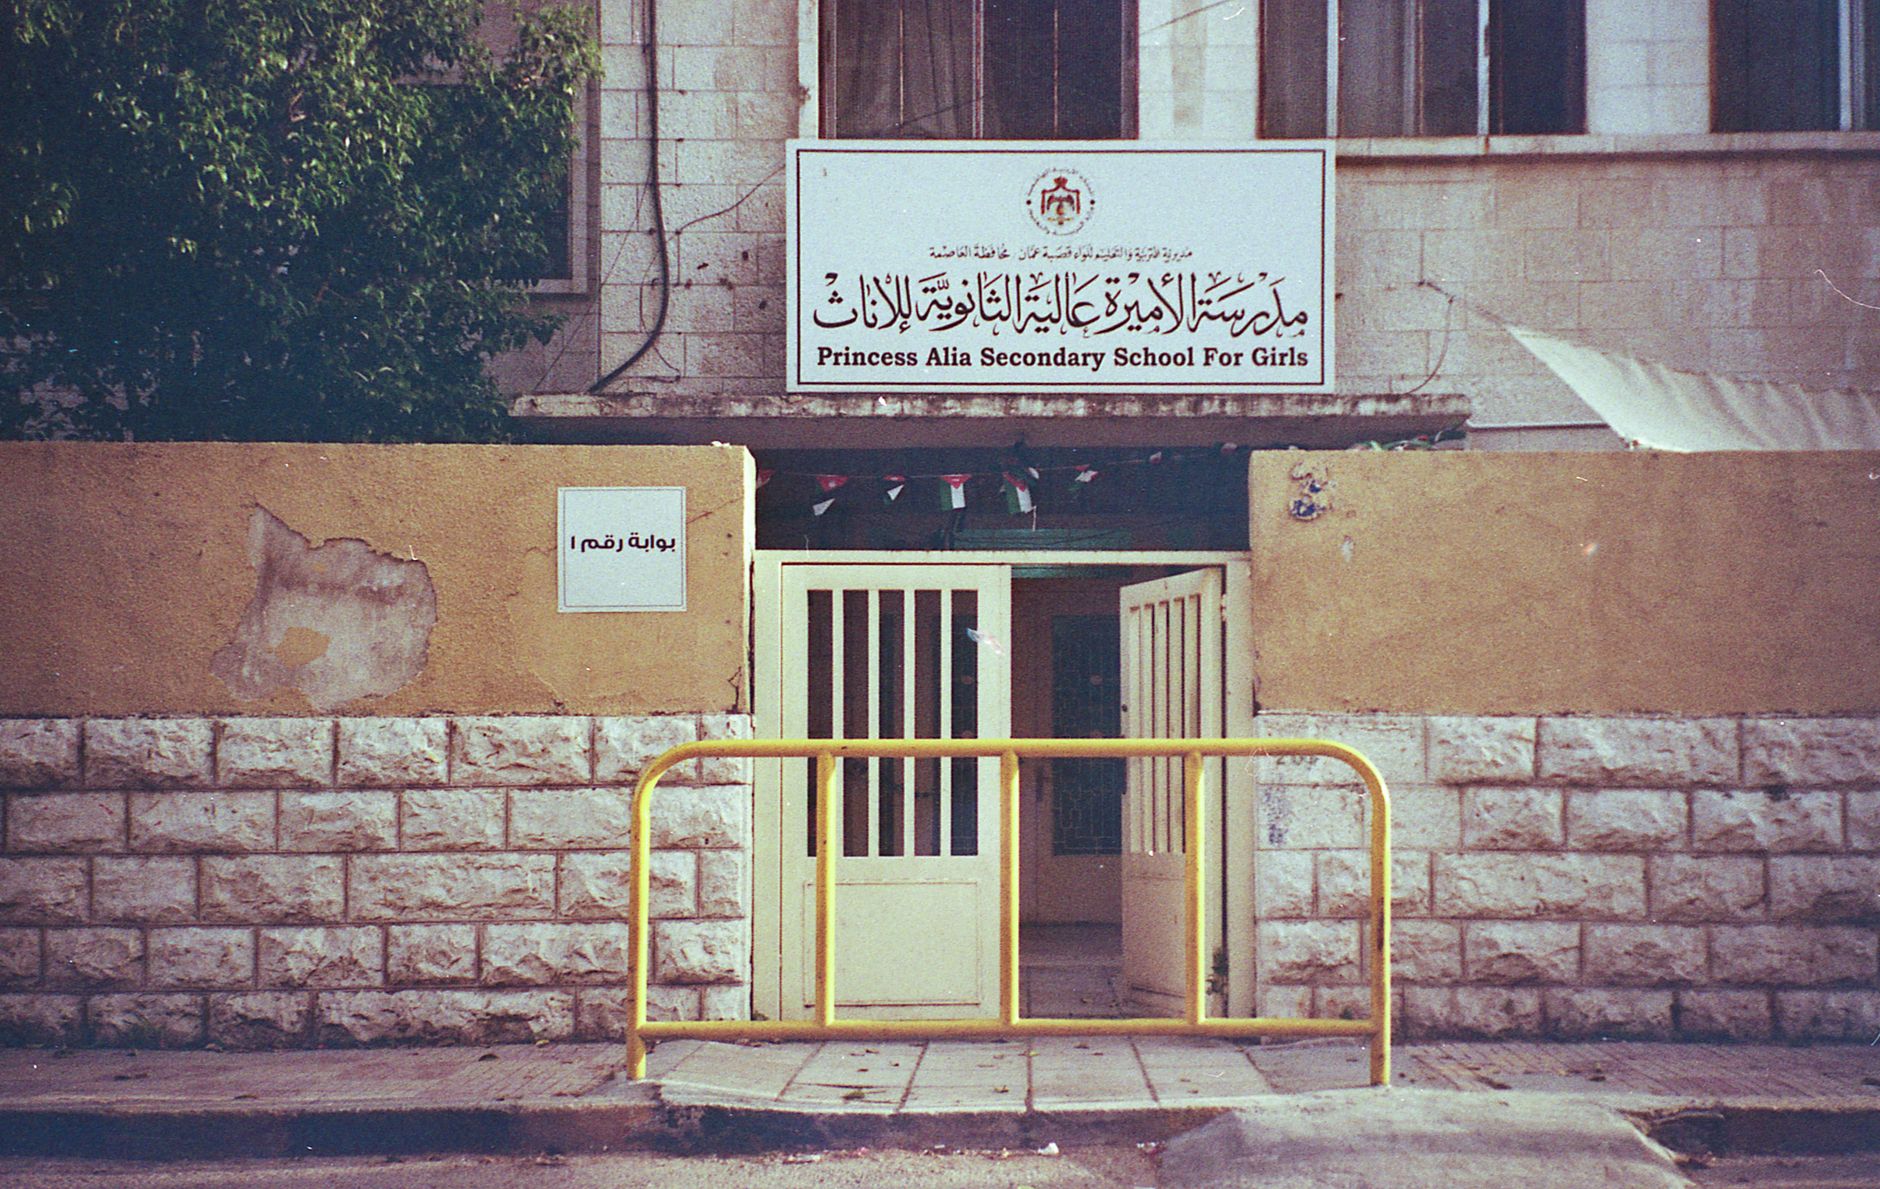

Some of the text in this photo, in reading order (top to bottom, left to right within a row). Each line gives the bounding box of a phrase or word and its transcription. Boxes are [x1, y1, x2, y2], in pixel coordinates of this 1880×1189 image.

[817, 346, 1309, 372] Princess Alia Secondary School For Girls
[580, 534, 624, 553] رقم
[627, 531, 676, 553] بوابة
